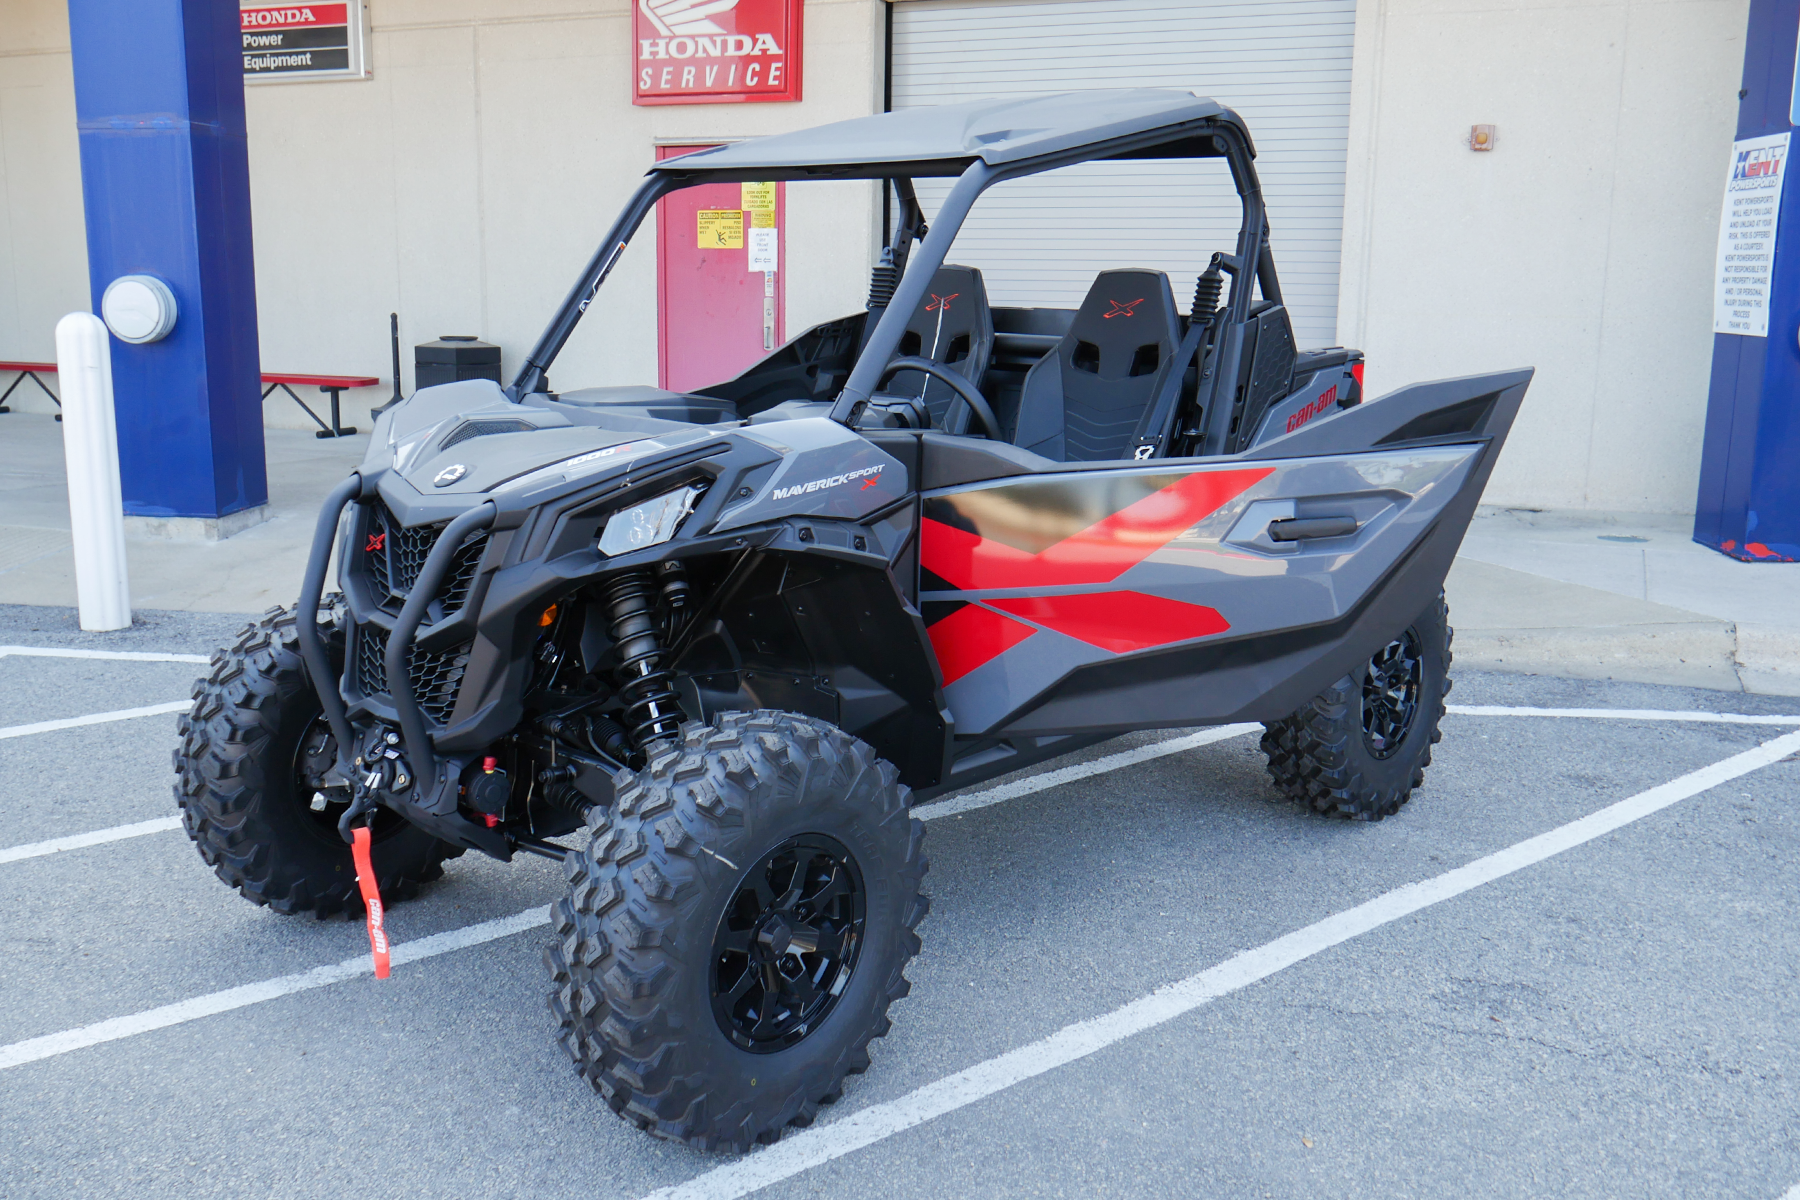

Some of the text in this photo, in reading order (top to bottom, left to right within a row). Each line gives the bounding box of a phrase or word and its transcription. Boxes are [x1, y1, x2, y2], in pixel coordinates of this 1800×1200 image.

[241, 8, 316, 26] HONDA
[242, 34, 283, 48] Power
[639, 33, 784, 60] HONDA
[243, 52, 312, 70] Equipment
[639, 62, 783, 90] SERVICE
[1733, 144, 1786, 179] KENT
[1728, 175, 1778, 192] POWERSPORTS
[1733, 195, 1774, 206] KENT POWERSPORTS
[1742, 208, 1752, 217] HELP
[1753, 208, 1761, 216] YOU
[1762, 207, 1773, 215] LOAD
[1729, 218, 1772, 229] AND UNLOAD AT YOUR
[1753, 230, 1771, 239] OFFERED
[1733, 243, 1739, 251] AS
[1725, 254, 1736, 262] KENT
[1736, 254, 1765, 262] POWERSPORTS
[1724, 265, 1768, 273] NOT RESPONSIBLE FOR
[1722, 276, 1768, 285] ANY PROPERTY DAMAGE
[1725, 287, 1734, 295] AND
[1743, 288, 1763, 297] PERSONAL
[1724, 298, 1762, 308] INJURY DURING THIS
[1732, 309, 1750, 318] PROCESS
[1728, 320, 1751, 330] THANK YOU
[566, 445, 632, 467] 1000R
[772, 464, 886, 500] MAVERICK SPORT
